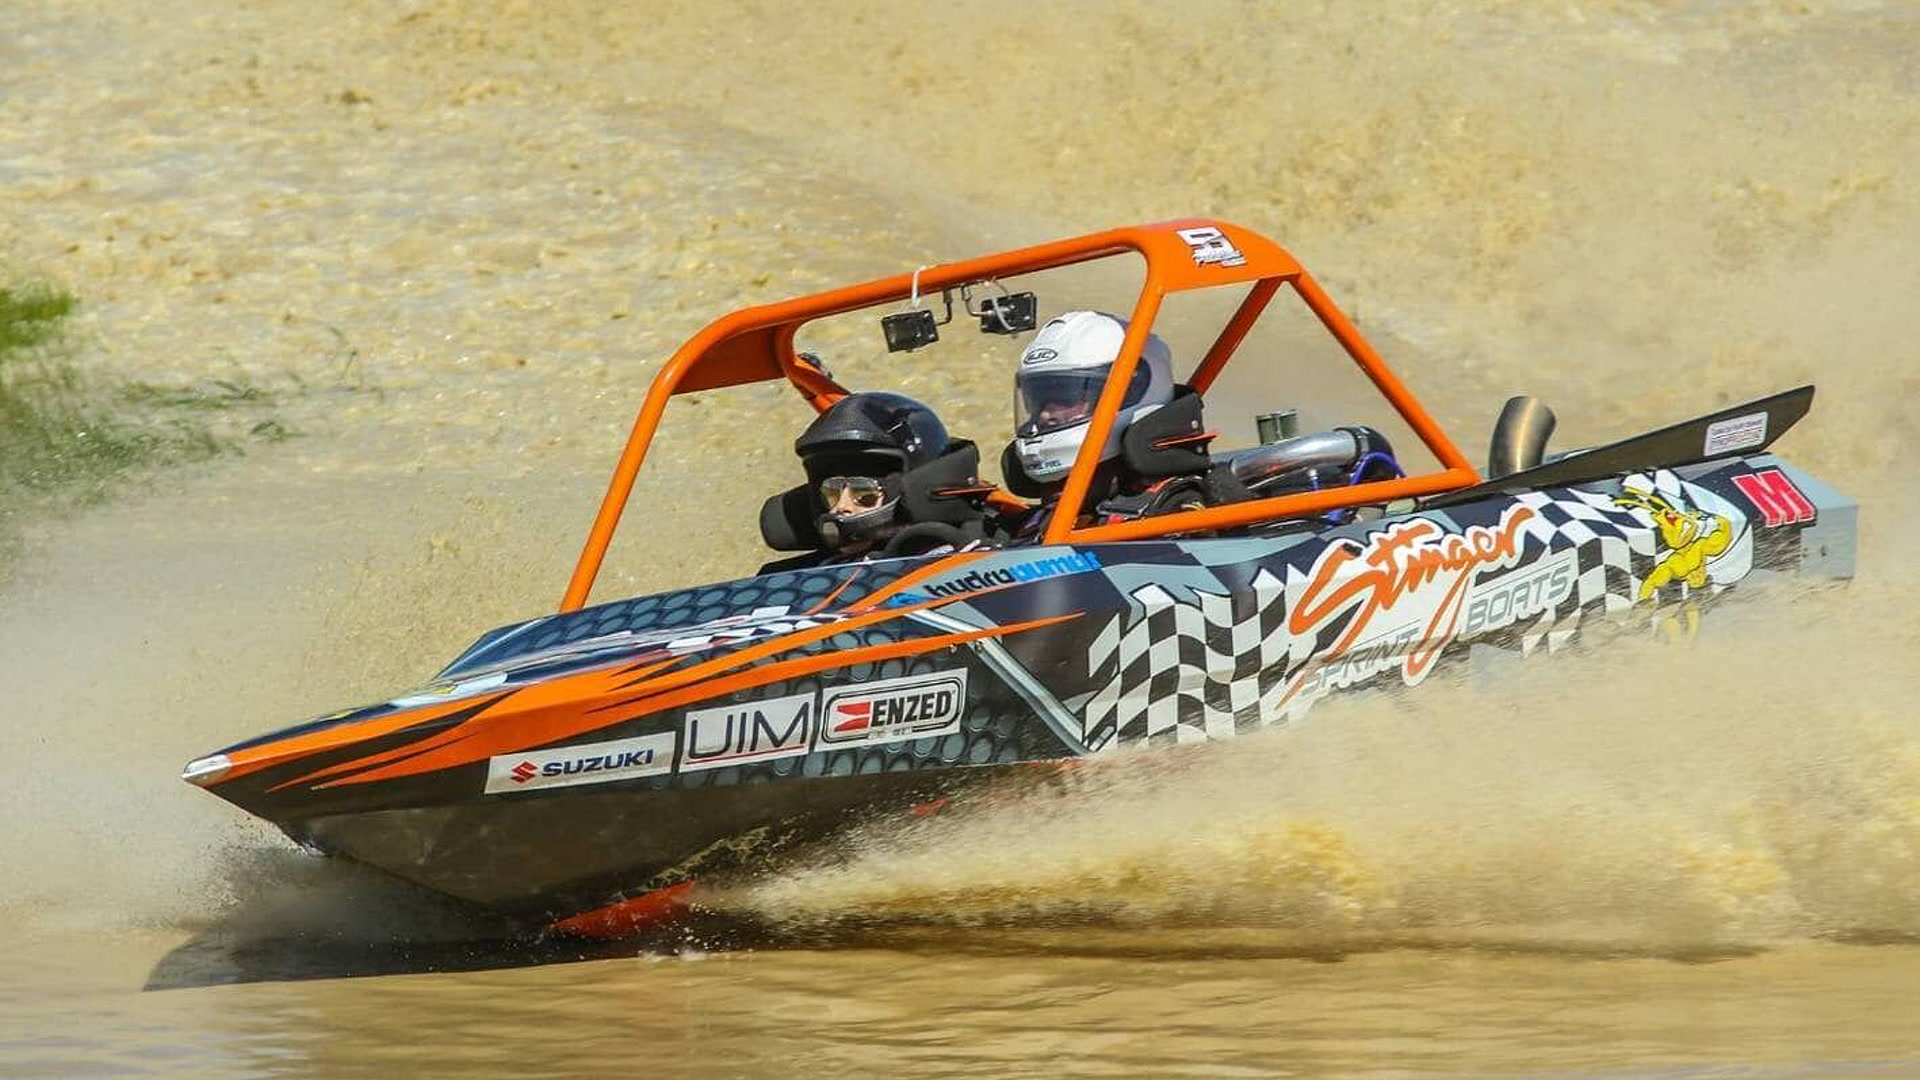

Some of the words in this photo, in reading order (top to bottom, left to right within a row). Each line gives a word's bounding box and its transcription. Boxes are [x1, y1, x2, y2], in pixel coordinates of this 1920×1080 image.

[1274, 505, 1535, 708] Stinger
[1466, 564, 1570, 632] BOATS
[688, 702, 810, 759] UIM
[870, 690, 953, 729] ENZED
[542, 749, 653, 777] SUZUKI
